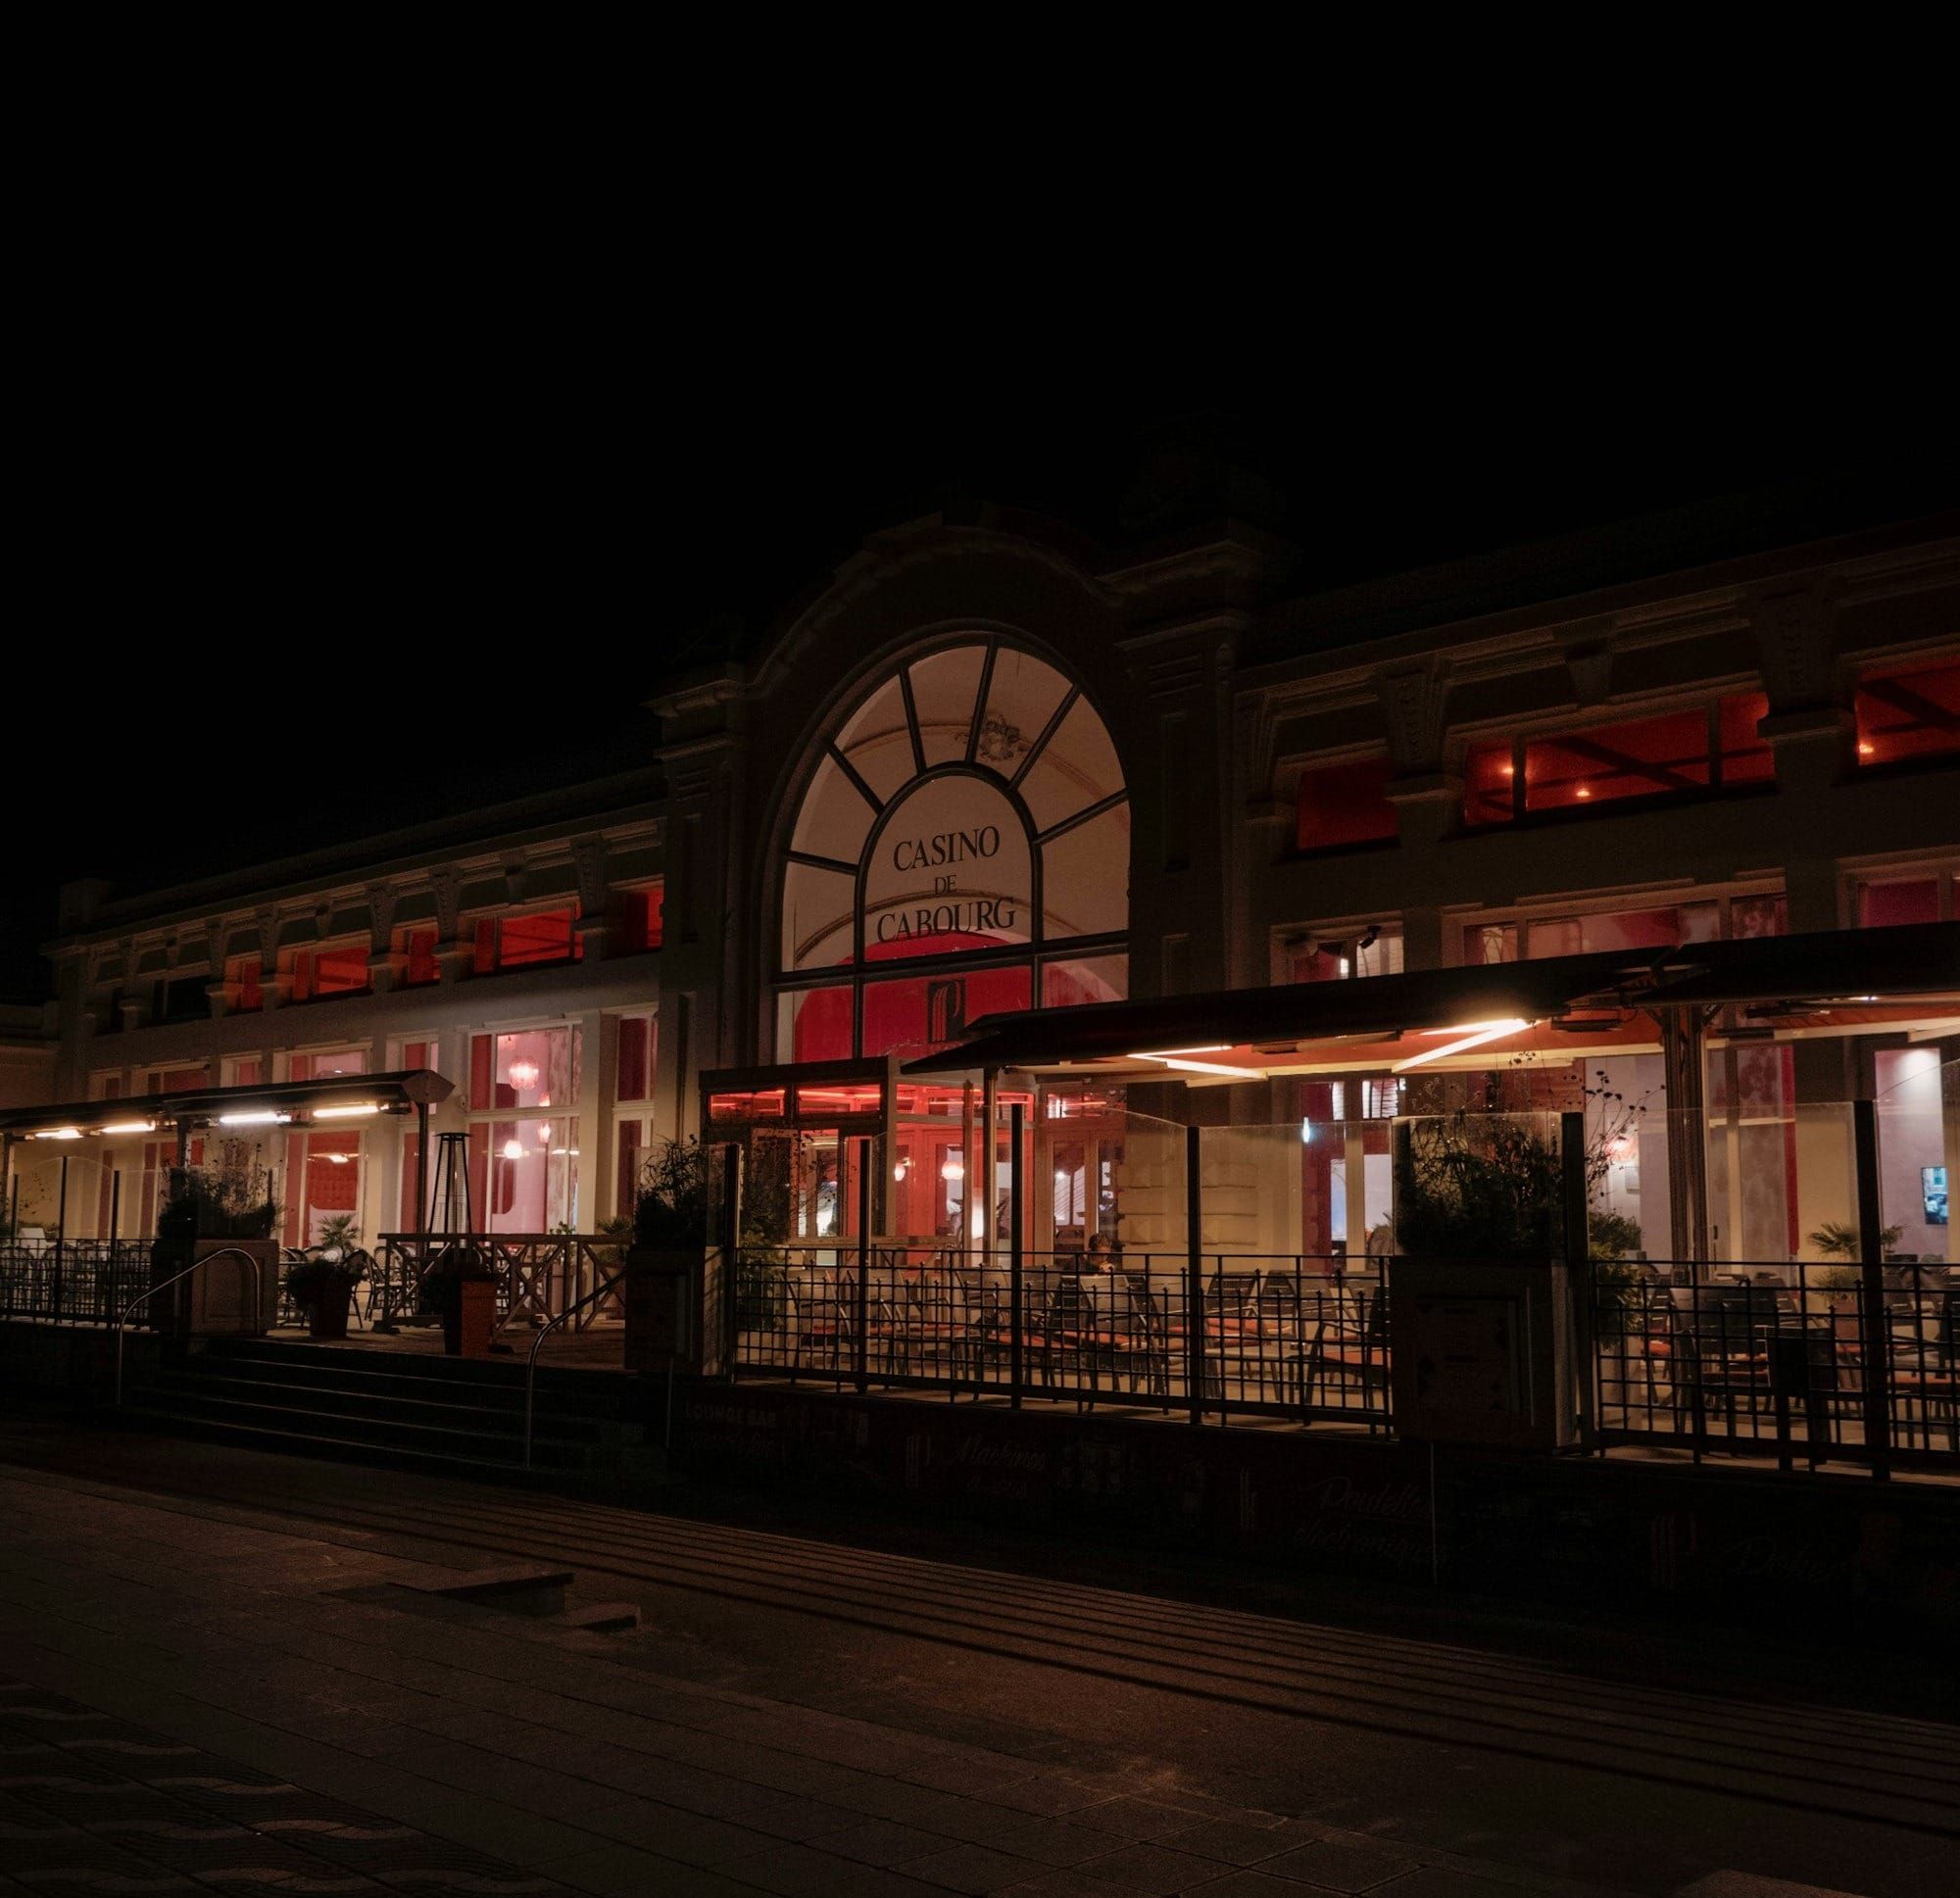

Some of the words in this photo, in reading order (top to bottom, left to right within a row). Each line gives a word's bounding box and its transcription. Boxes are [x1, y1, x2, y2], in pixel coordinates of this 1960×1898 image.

[893, 826, 1000, 871] CASINO
[934, 874, 957, 896] DE
[877, 897, 1015, 943] CABOURG
